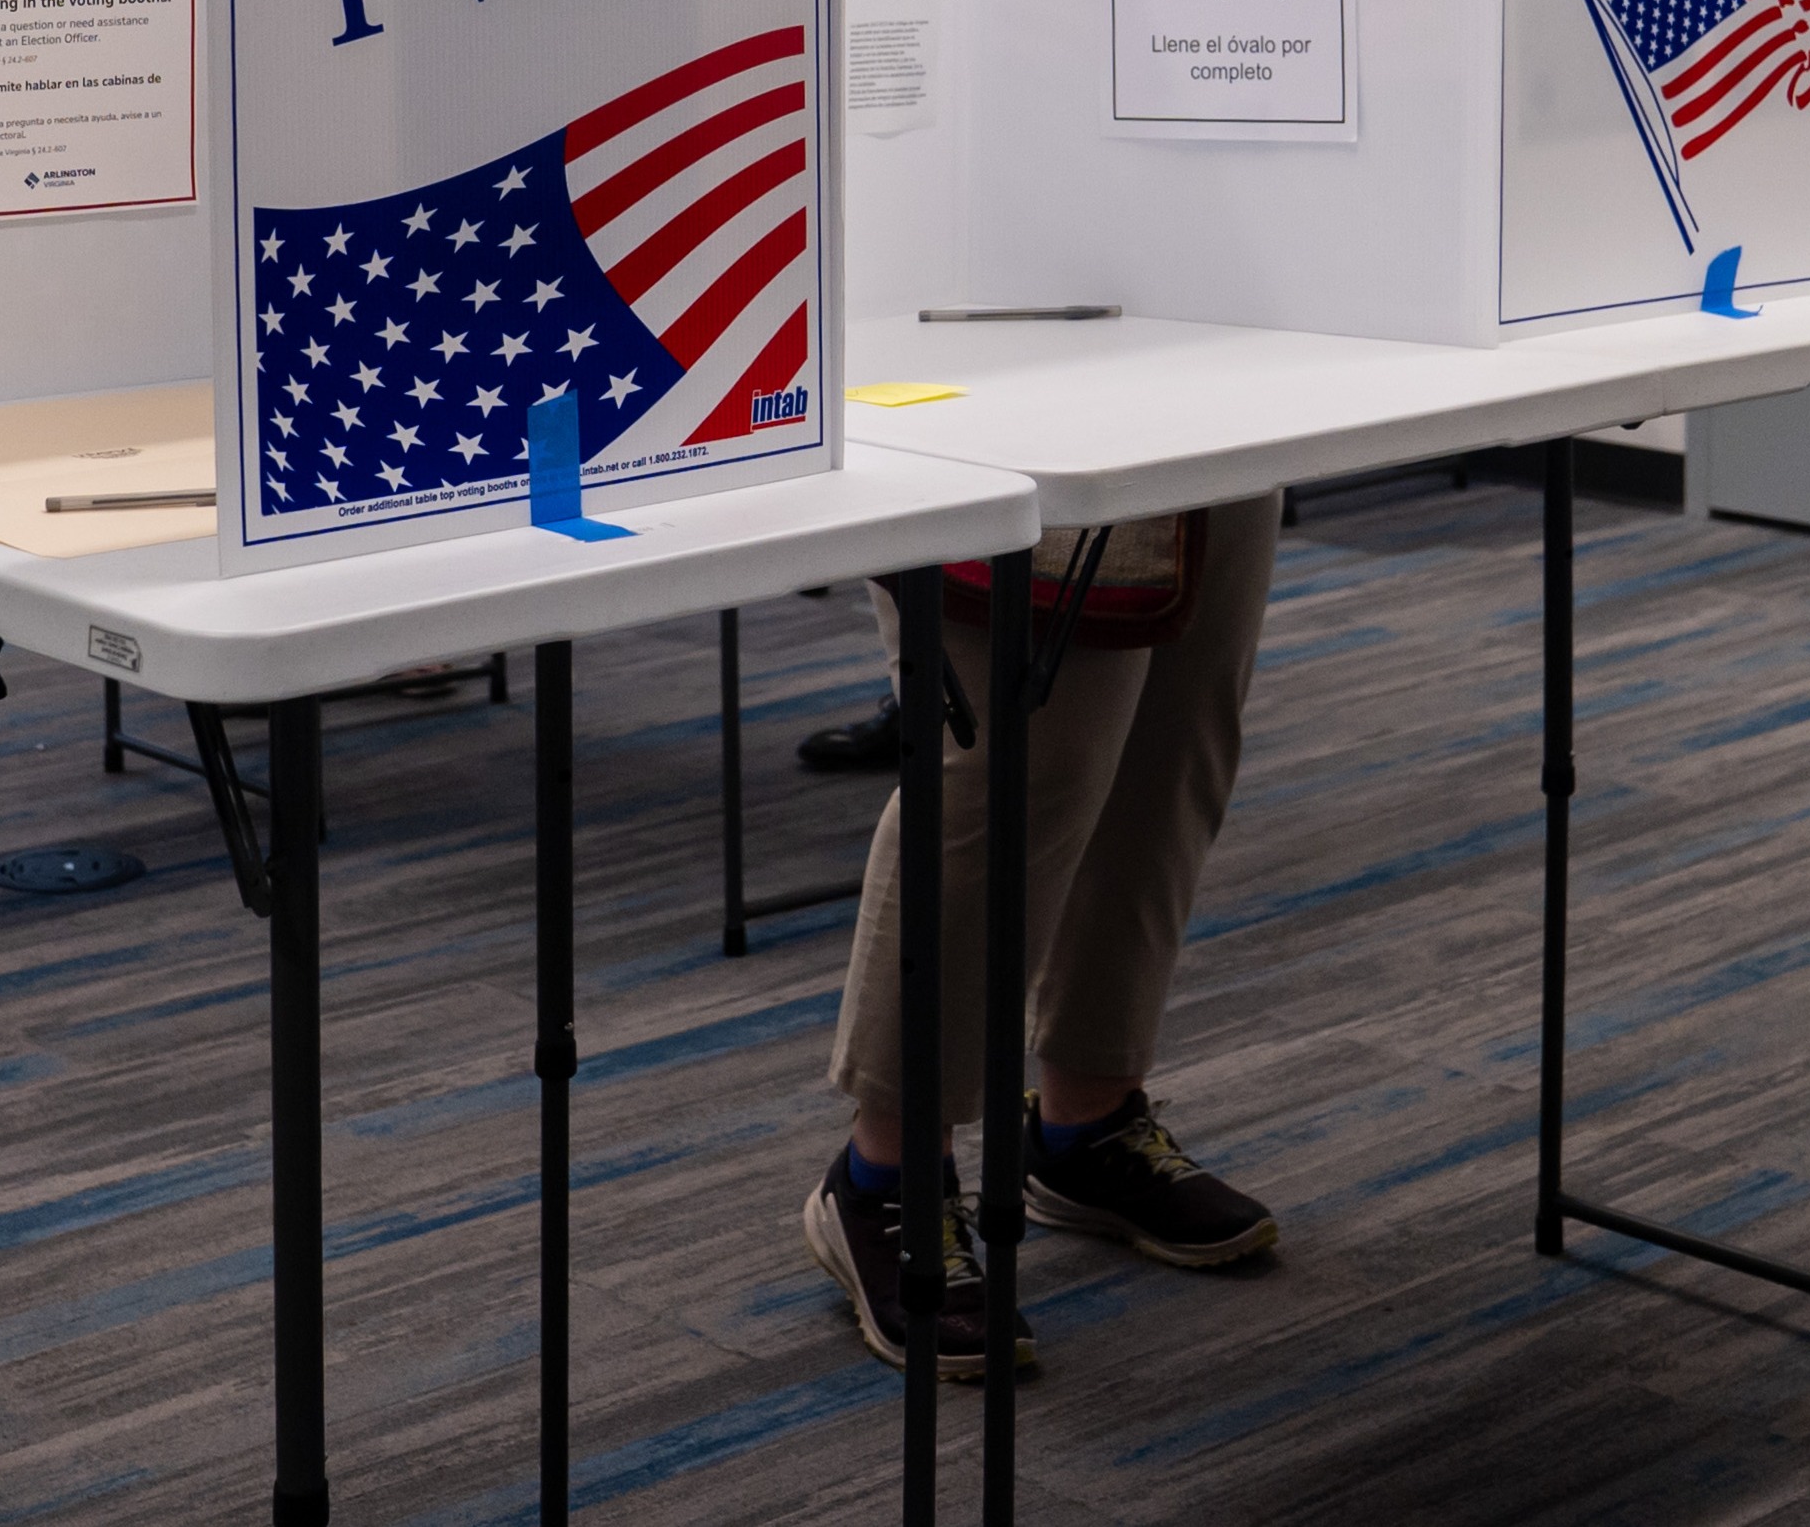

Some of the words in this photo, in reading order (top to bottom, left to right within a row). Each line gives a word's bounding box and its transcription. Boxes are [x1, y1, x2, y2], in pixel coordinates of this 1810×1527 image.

[0, 24, 7, 32] a
[9, 20, 54, 32] question
[57, 21, 67, 29] or
[69, 18, 94, 28] need
[97, 16, 149, 27] assistance
[5, 38, 18, 46] an
[21, 35, 61, 46] Election
[64, 32, 101, 44] Officer.
[1152, 35, 1200, 53] Llene
[1206, 35, 1221, 53] el
[1227, 35, 1276, 54] óvalo
[1282, 38, 1312, 57] por
[25, 80, 62, 92] hablar
[65, 80, 79, 89] en
[83, 76, 99, 88] las
[102, 74, 145, 86] cabinas
[147, 73, 162, 84] de
[1190, 63, 1273, 83] completo
[6, 118, 45, 129] pregunta
[54, 114, 89, 125] necesita
[91, 112, 119, 123] ayuda,
[121, 111, 143, 120] avise
[151, 111, 162, 119] un
[43, 168, 96, 179] ARLINGTON
[751, 385, 809, 424] intab
[338, 505, 365, 517] Order
[368, 498, 413, 513] additional
[415, 493, 438, 505] table
[440, 490, 455, 502] top
[457, 485, 485, 498] voting
[487, 479, 518, 494] booths
[580, 461, 620, 477] .intab.net
[621, 460, 630, 469] or
[631, 457, 646, 468] call
[649, 446, 709, 465] 1.800.232.1872.
